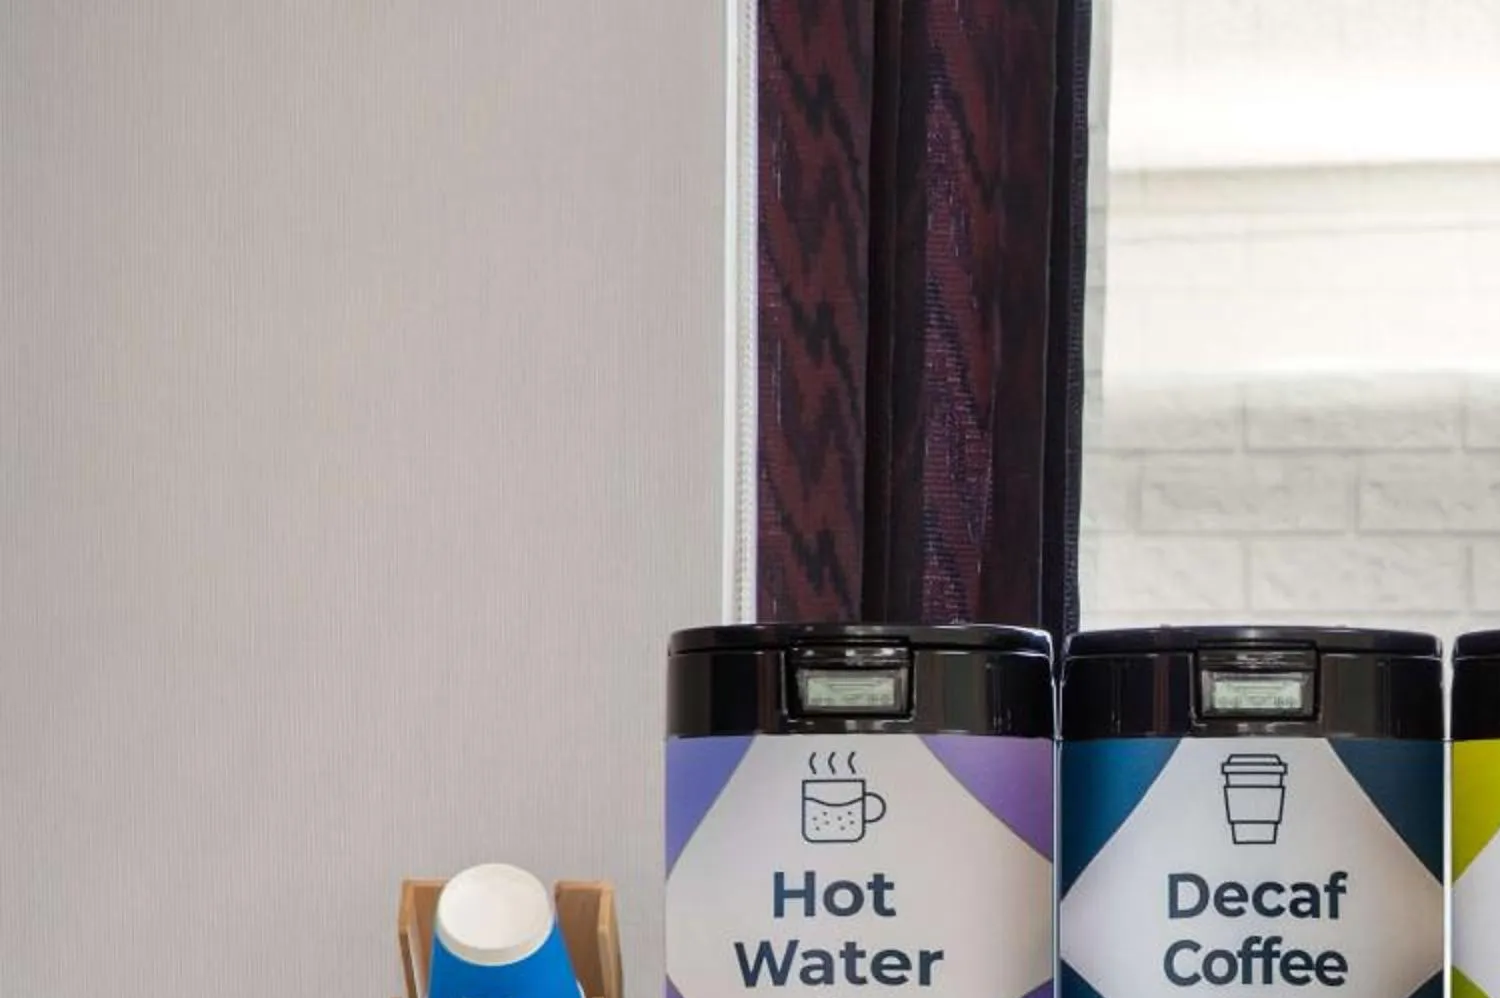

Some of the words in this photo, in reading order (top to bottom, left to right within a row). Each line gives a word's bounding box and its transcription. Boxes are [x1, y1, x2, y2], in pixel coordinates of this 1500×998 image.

[774, 871, 896, 917] Hot
[1169, 871, 1348, 919] Decaf
[734, 940, 943, 987] Water
[1164, 936, 1348, 986] Coffee
